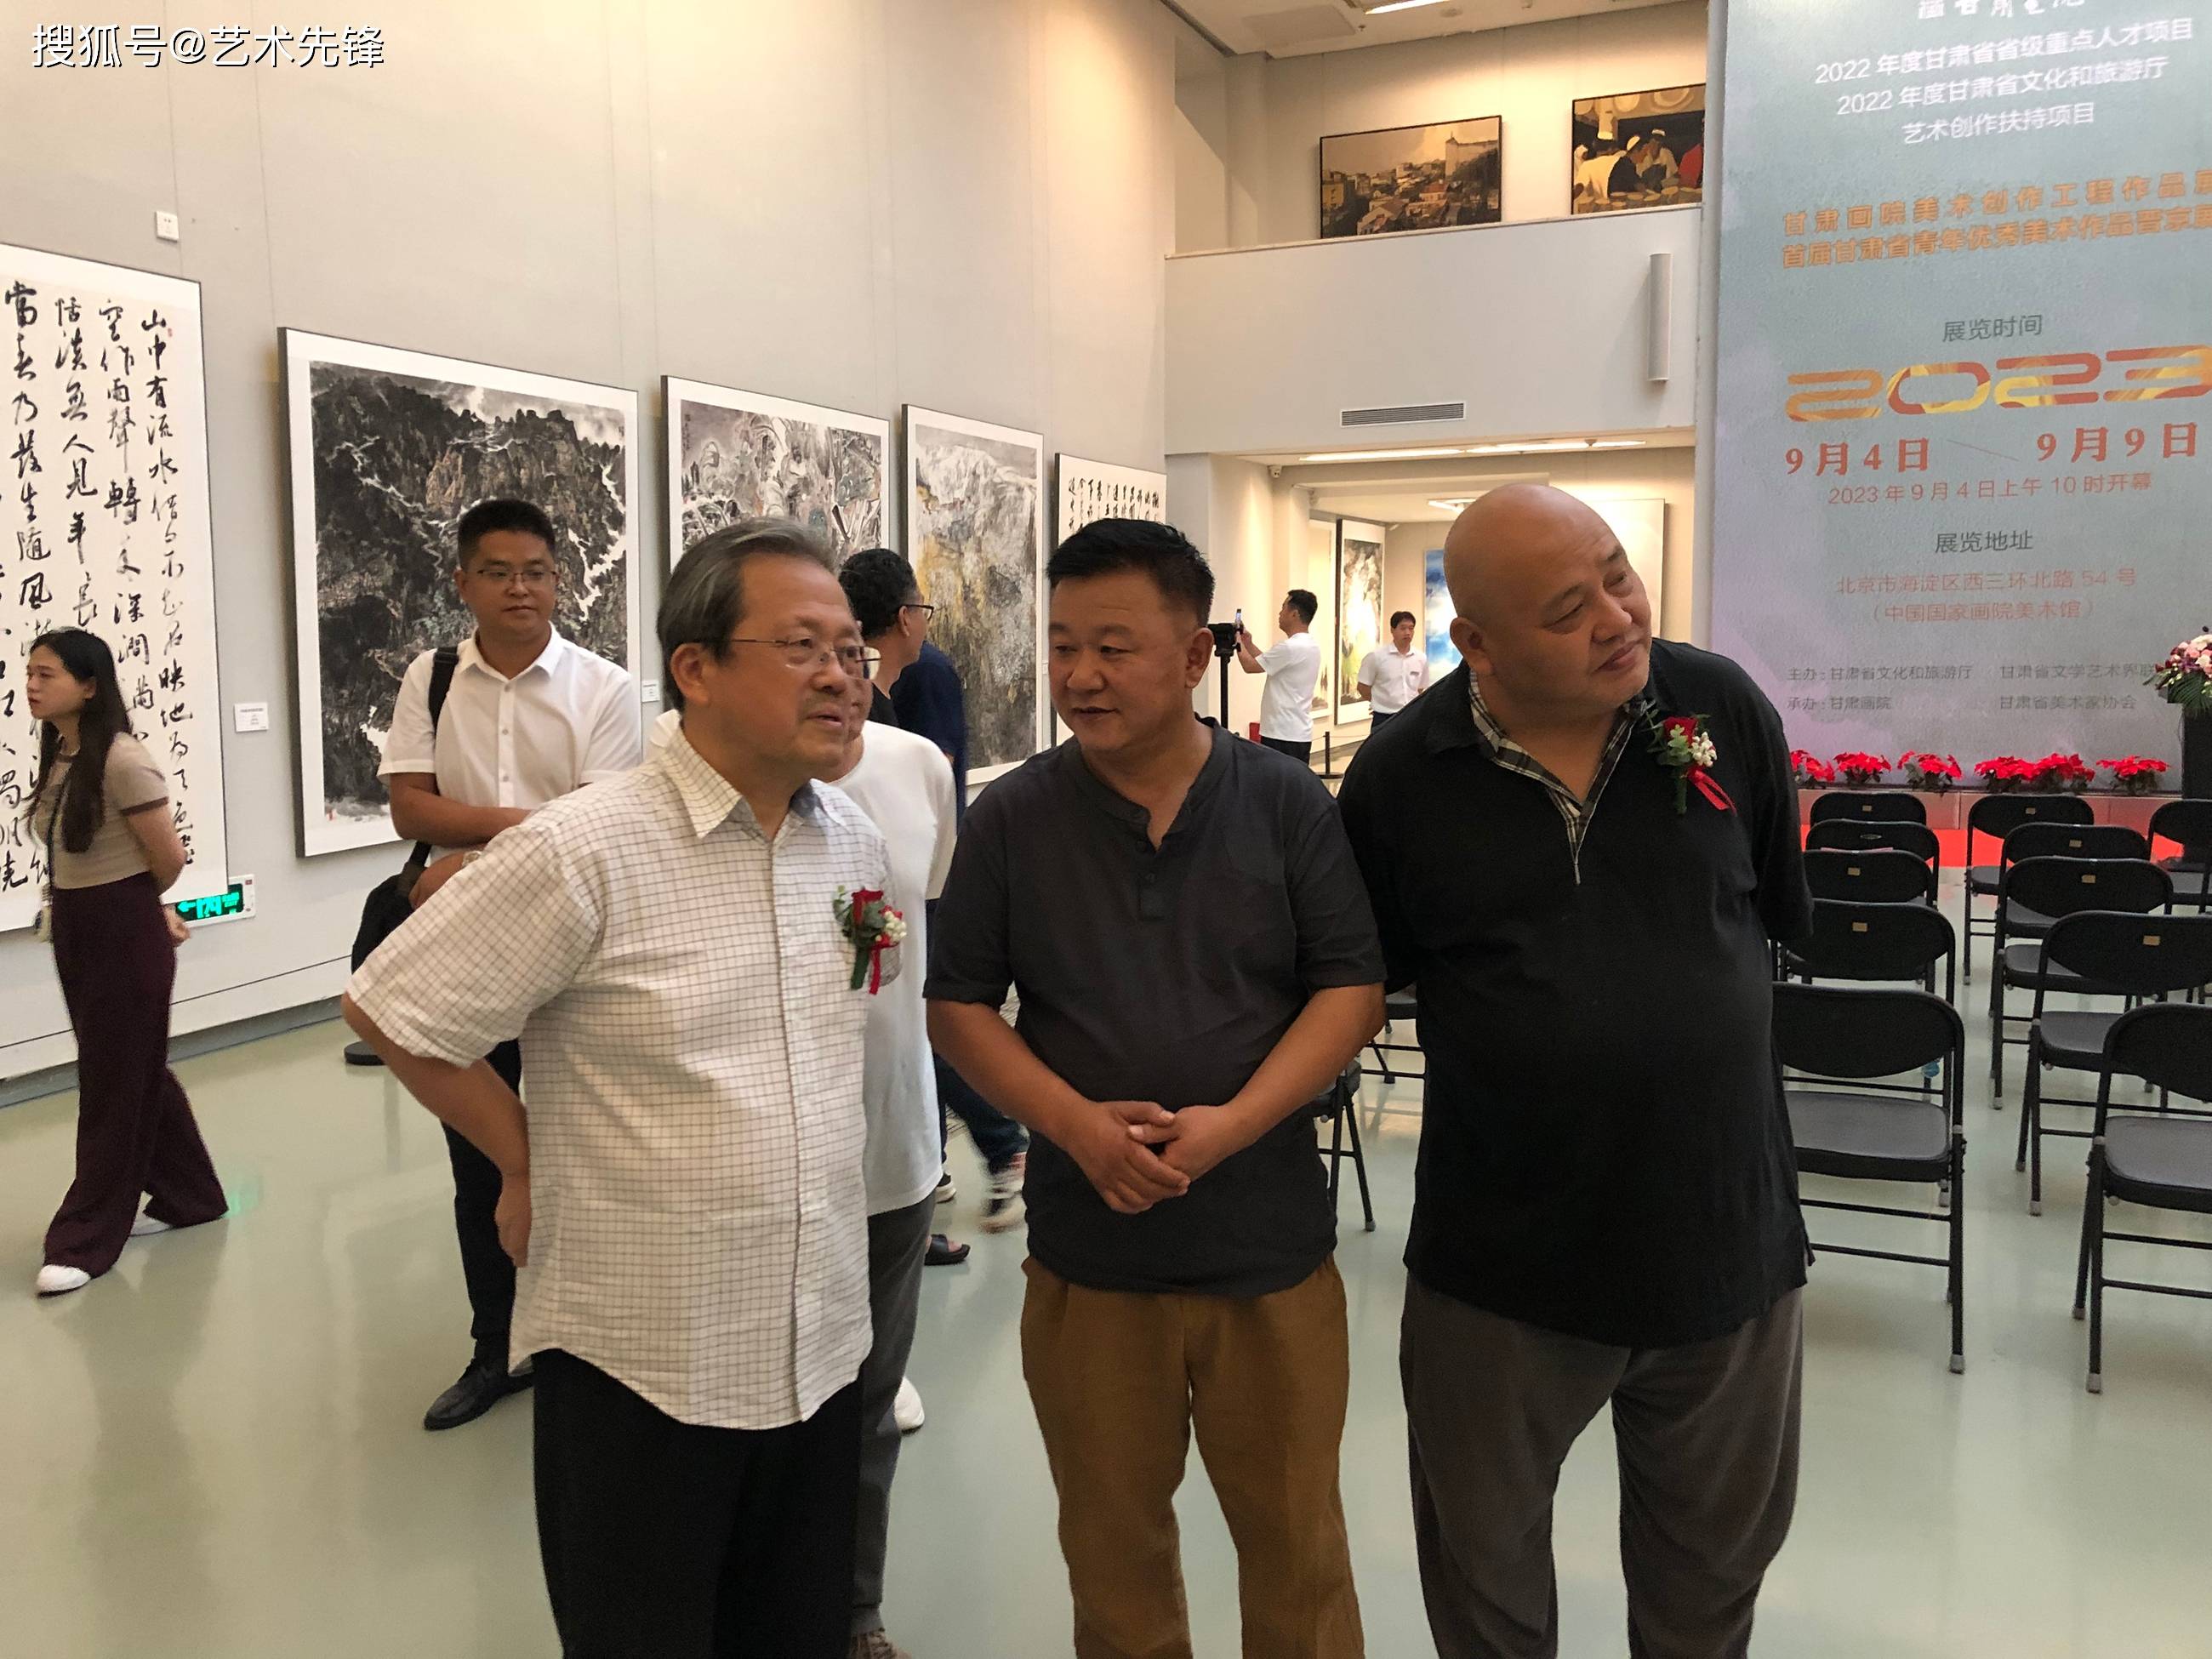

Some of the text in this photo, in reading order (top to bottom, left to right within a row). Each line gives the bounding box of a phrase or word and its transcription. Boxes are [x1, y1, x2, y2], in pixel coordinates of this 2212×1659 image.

[1902, 102, 2095, 145] 艺术创作扶持项目
[1942, 313, 2044, 343] 展览时间
[1784, 344, 2212, 423] 2023
[1934, 529, 2034, 555] 展览地址
